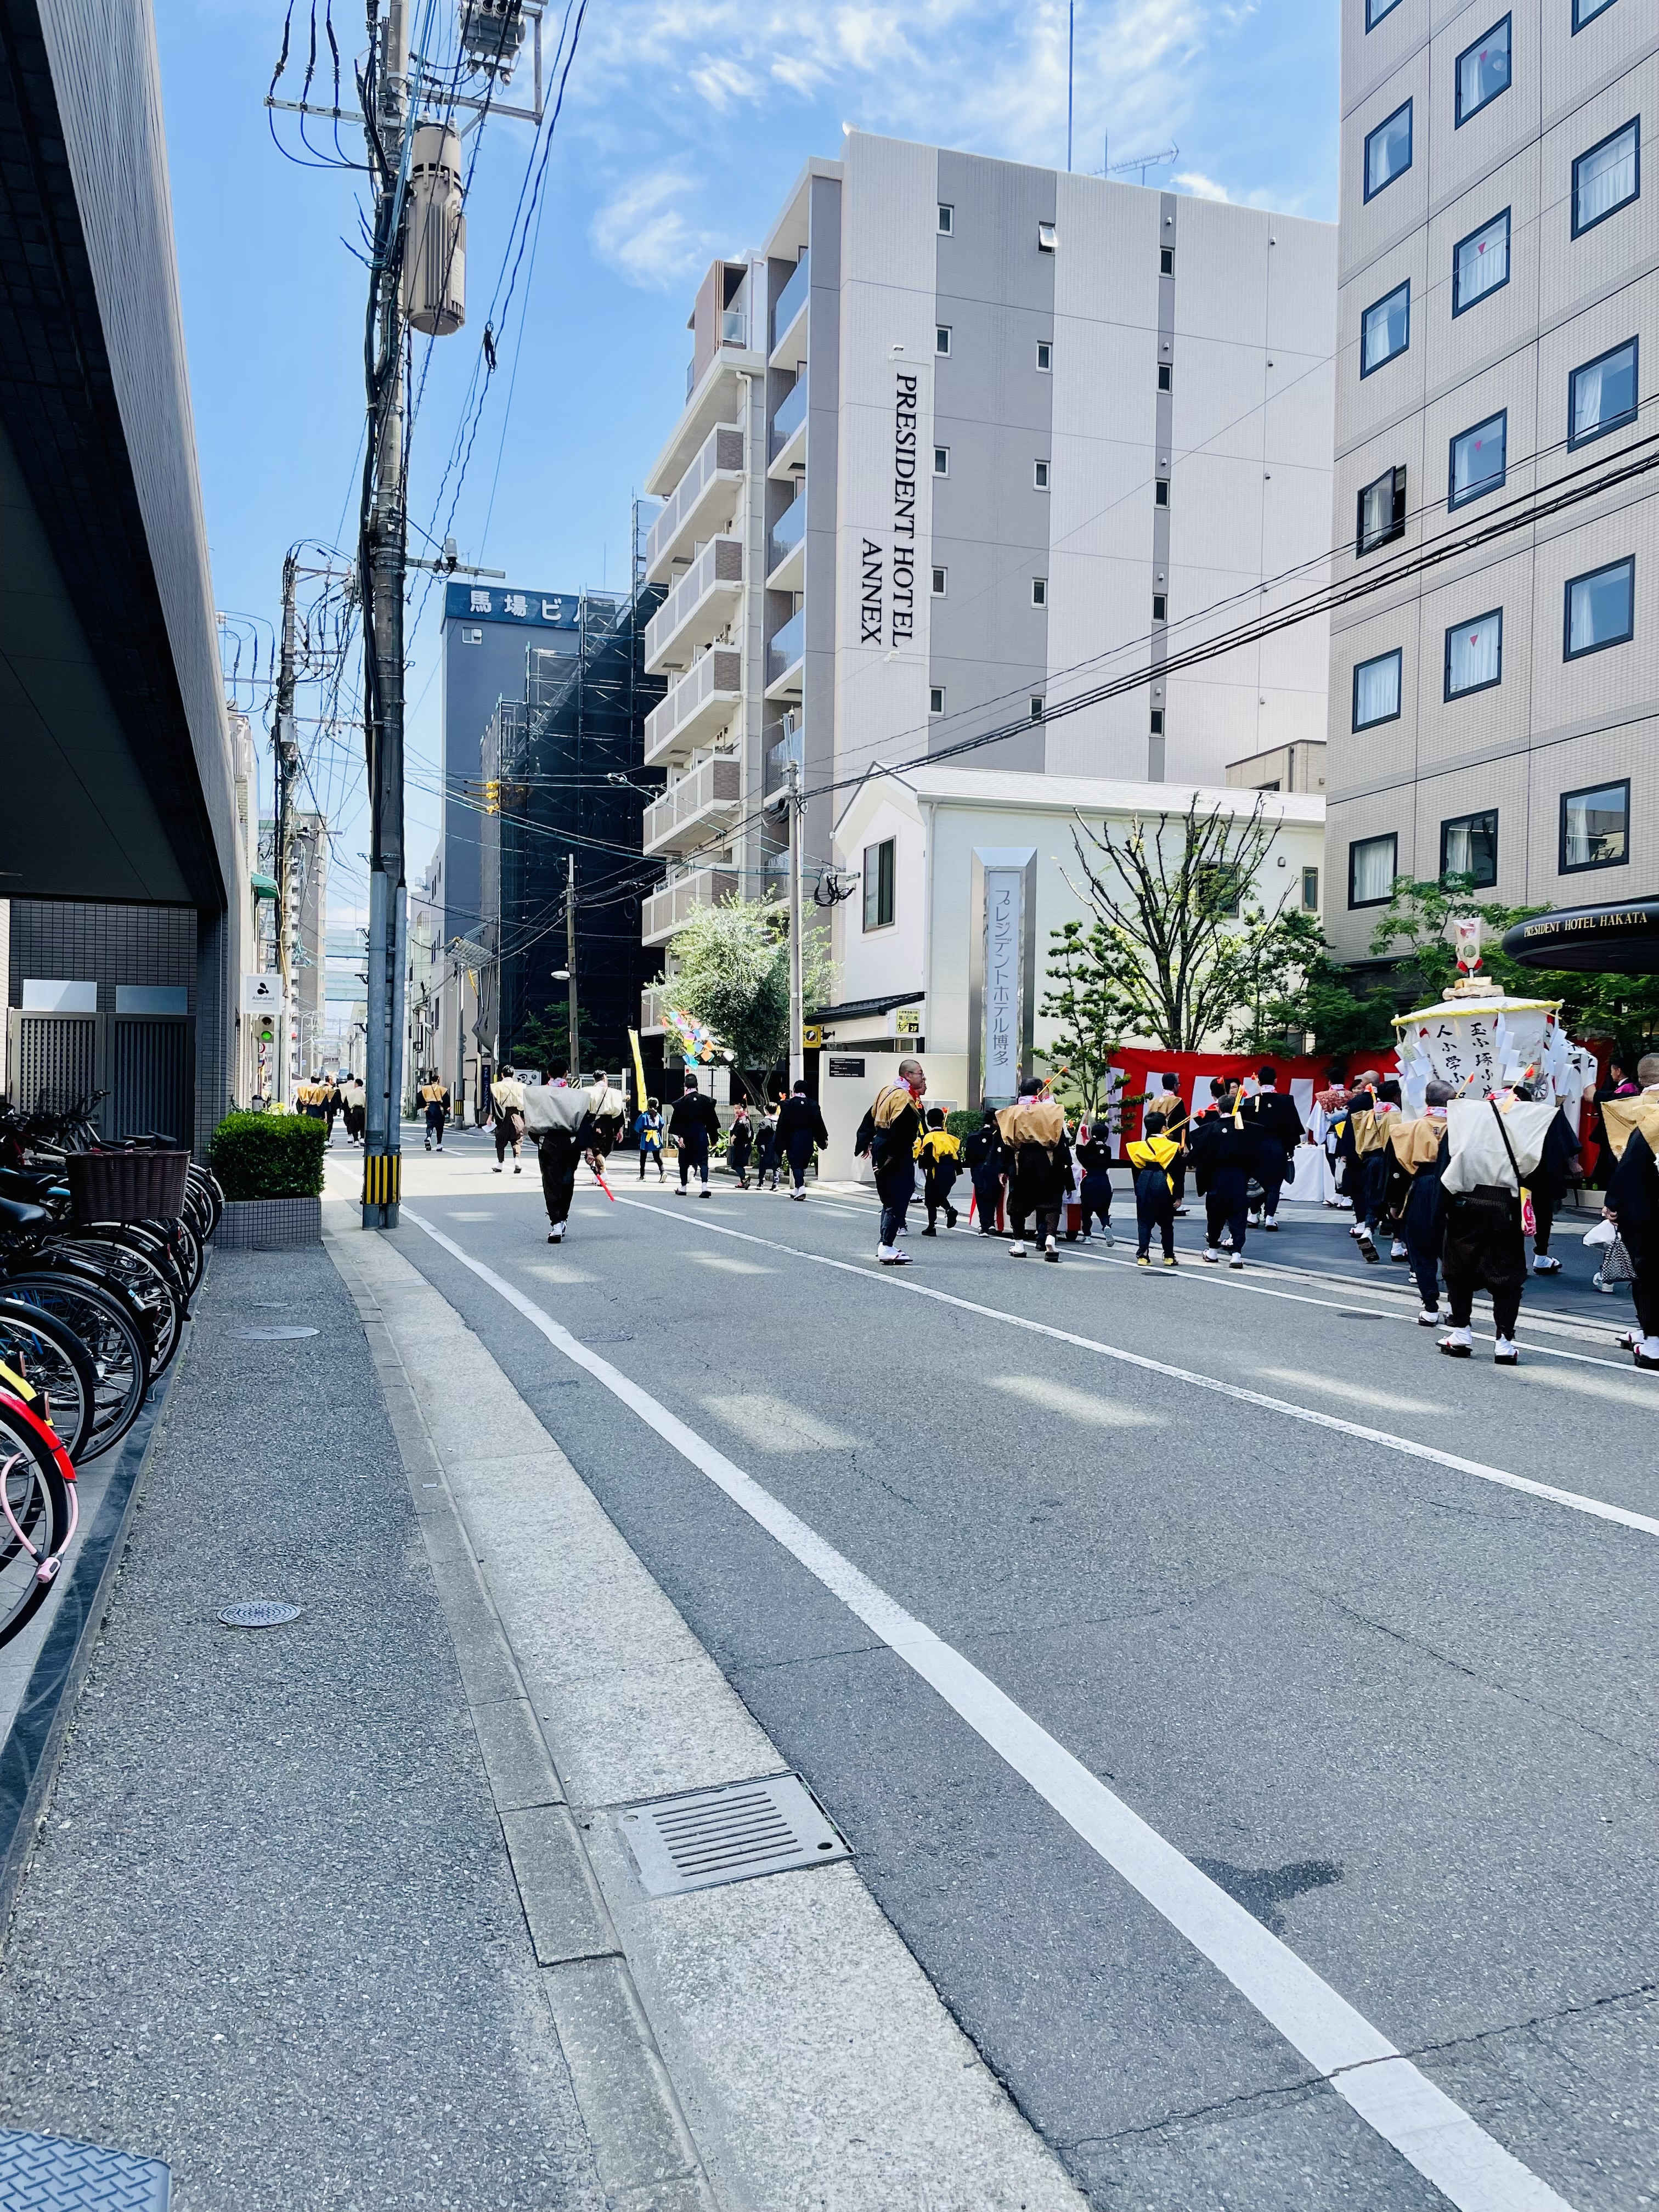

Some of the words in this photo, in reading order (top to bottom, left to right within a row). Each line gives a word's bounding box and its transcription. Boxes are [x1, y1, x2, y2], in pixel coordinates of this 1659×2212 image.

[893, 373, 917, 539] PRESIDENT
[470, 590, 580, 622] 馬場ビ
[861, 537, 883, 646] ANNEX
[891, 545, 915, 647] HOTEL
[1523, 921, 1561, 938] PRESIDENT
[1564, 916, 1596, 931] HOTEL
[1600, 912, 1647, 927] HAKATA
[993, 890, 1012, 1066] プレジデントホテル博多
